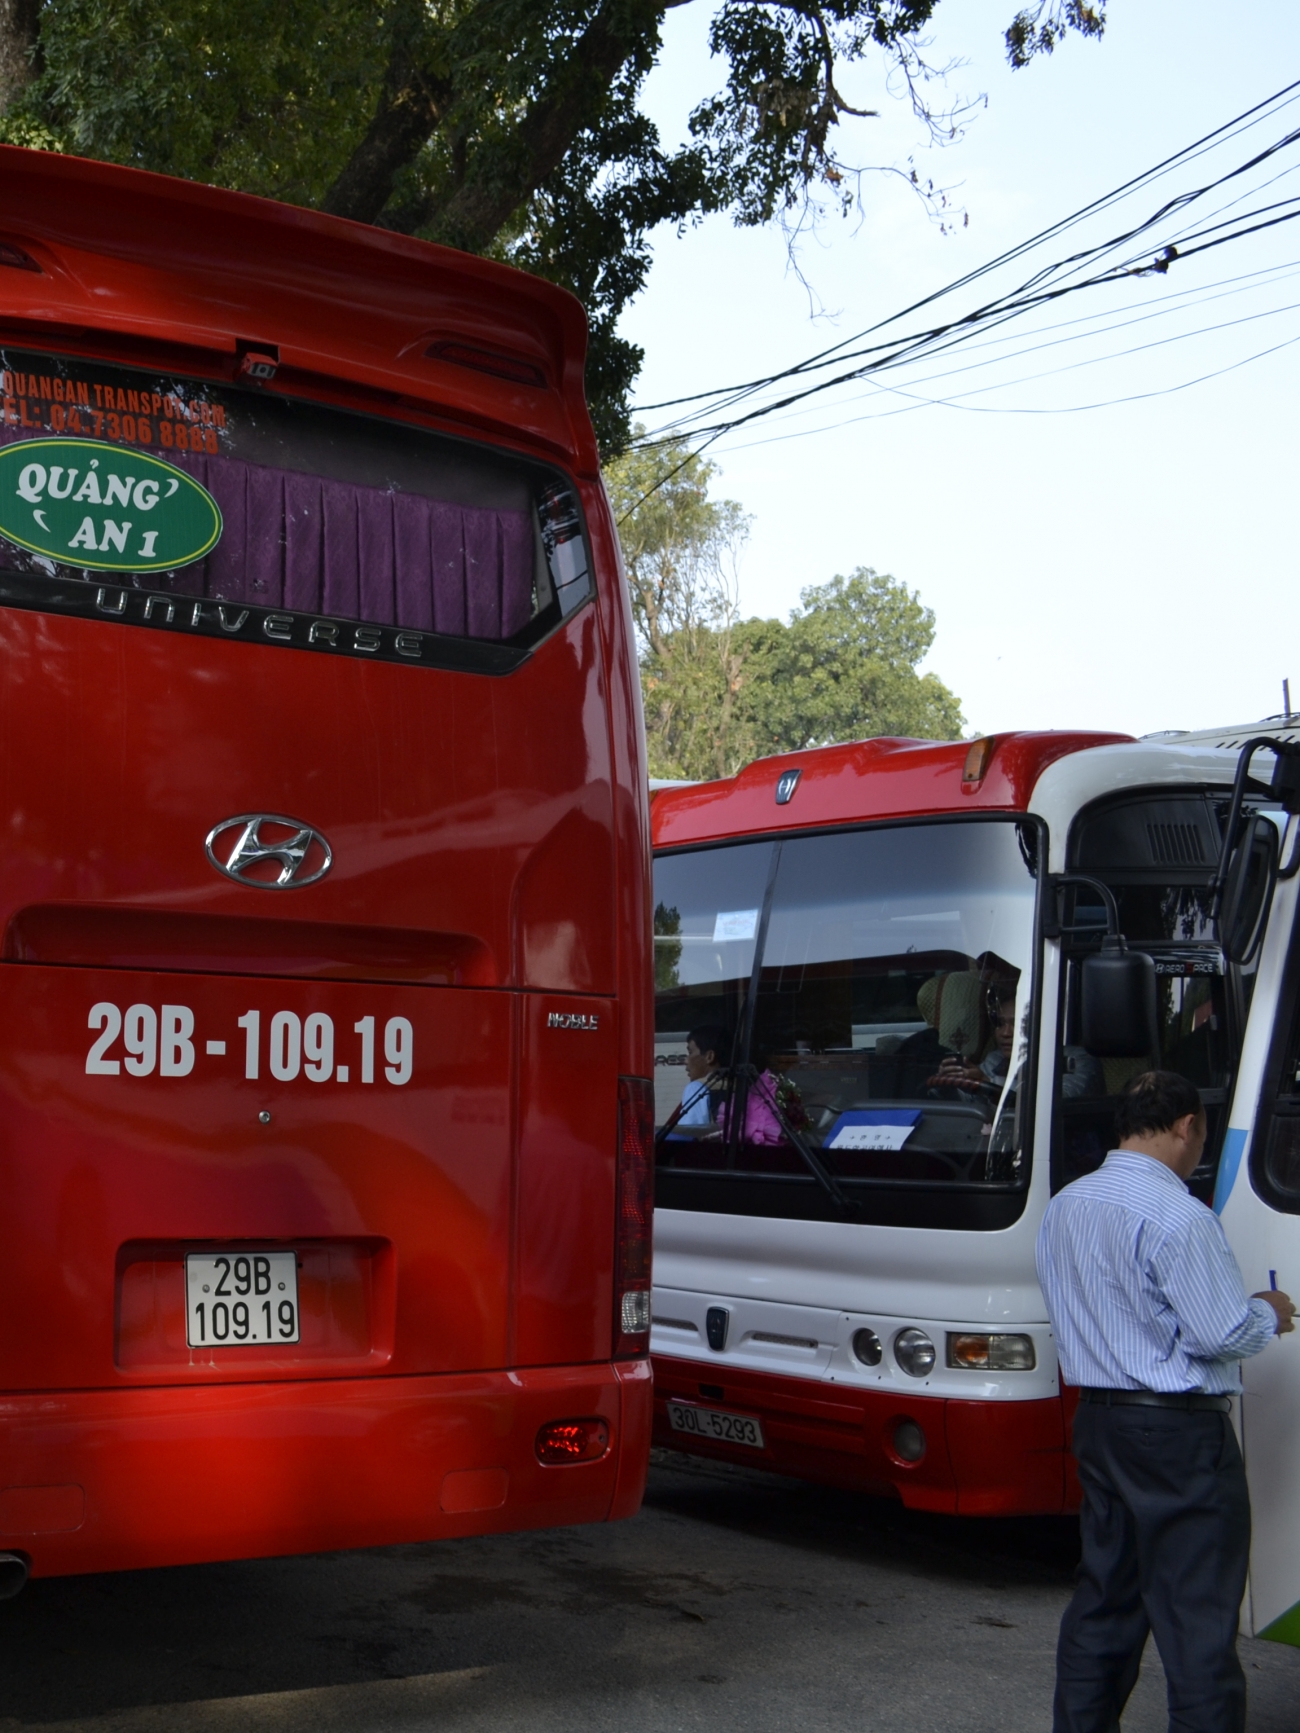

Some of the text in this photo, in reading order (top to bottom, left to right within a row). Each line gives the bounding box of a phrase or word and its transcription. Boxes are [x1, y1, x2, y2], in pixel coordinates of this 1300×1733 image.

[3, 370, 89, 405] QUANGAN
[93, 384, 226, 427] TRANSPOT.COM
[51, 403, 152, 444] 04.7306
[159, 420, 218, 455] 8888
[68, 516, 159, 557] AN 1
[96, 588, 423, 657] UNIVERSE
[547, 1012, 598, 1030] NOBLE
[214, 1256, 271, 1296] 29B
[195, 1300, 295, 1341] 109.19
